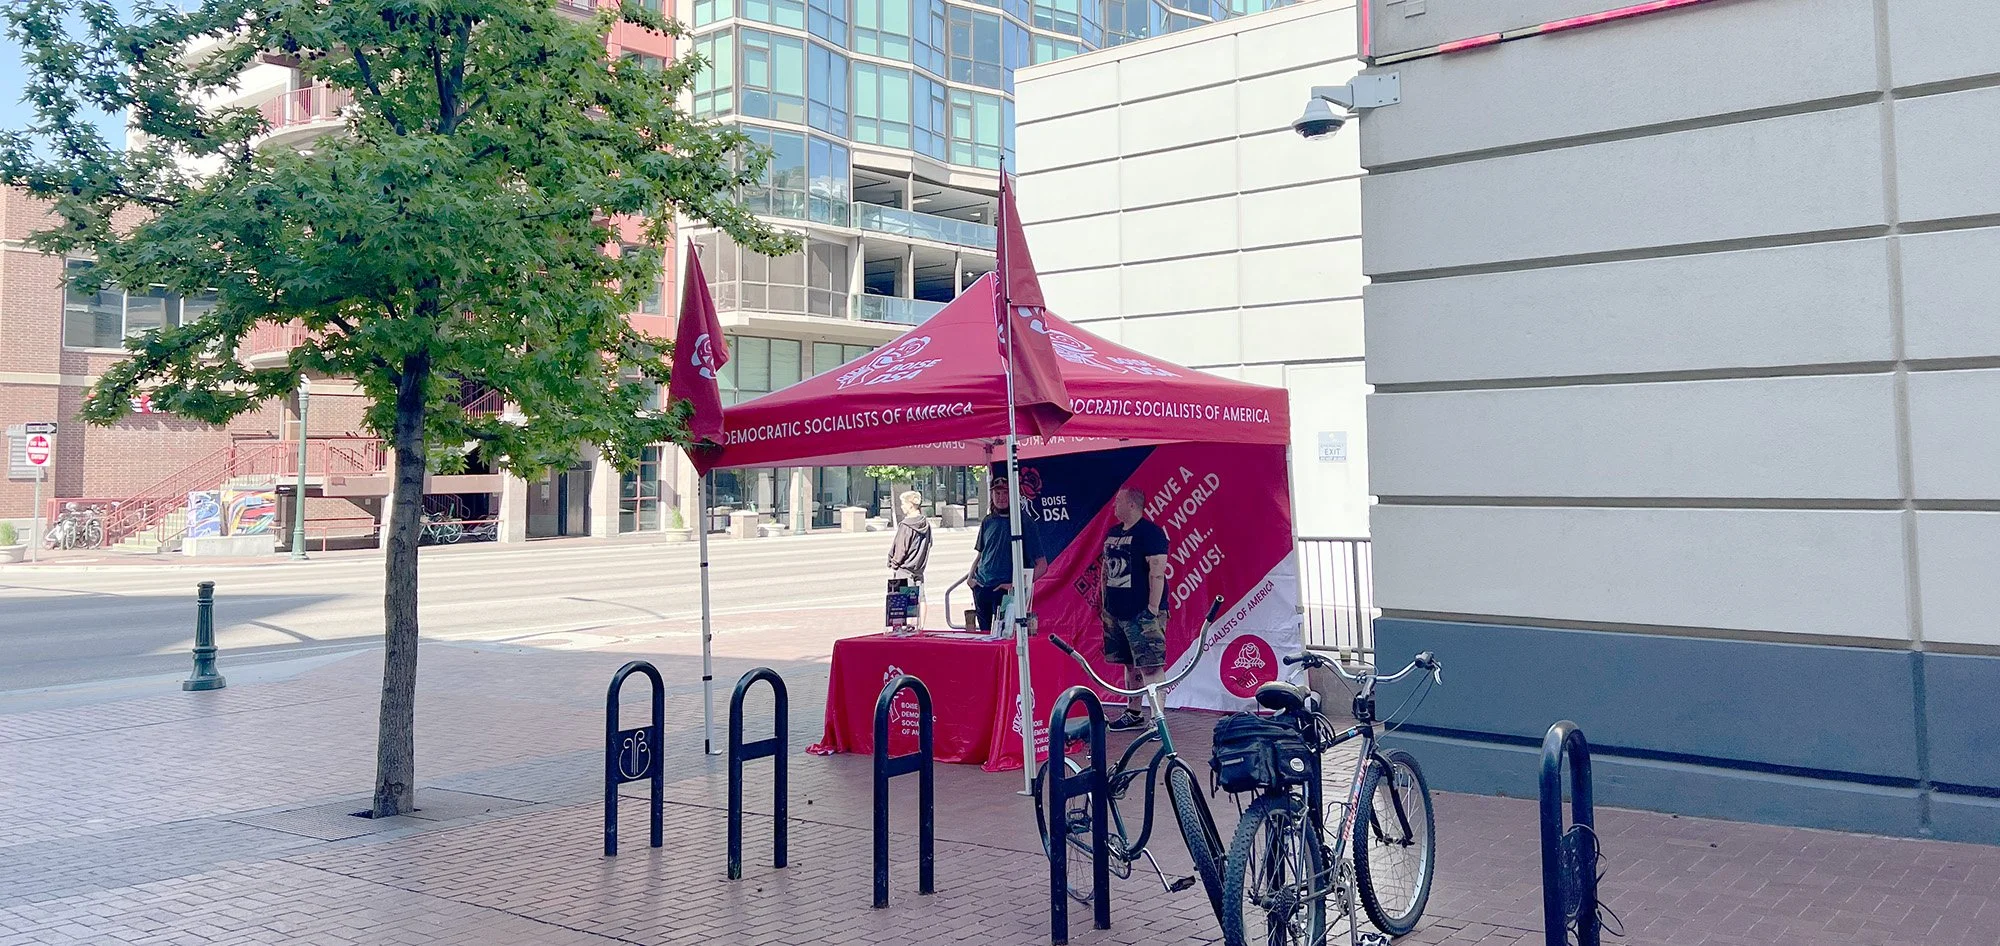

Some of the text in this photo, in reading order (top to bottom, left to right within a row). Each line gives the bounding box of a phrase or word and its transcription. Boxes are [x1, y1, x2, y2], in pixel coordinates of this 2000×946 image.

[864, 369, 923, 386] DSA
[886, 358, 942, 373] BOISE
[804, 411, 879, 435] SOCIALISTS
[882, 408, 902, 425] OF
[906, 401, 974, 422] AMERICA
[1134, 400, 1202, 420] SOCIALISTS
[1205, 405, 1220, 420] OF
[1223, 407, 1270, 424] AMERICA
[1041, 495, 1067, 507] BOISE
[1143, 466, 1194, 522] HAVE A
[1167, 472, 1220, 531] WORLD
[1043, 507, 1070, 522] DSA
[1171, 528, 1213, 566] WIN...
[1170, 544, 1226, 610] JOIN US!
[1202, 580, 1275, 652] OCIALISTS OF AMERICA
[900, 702, 919, 710] BOISE
